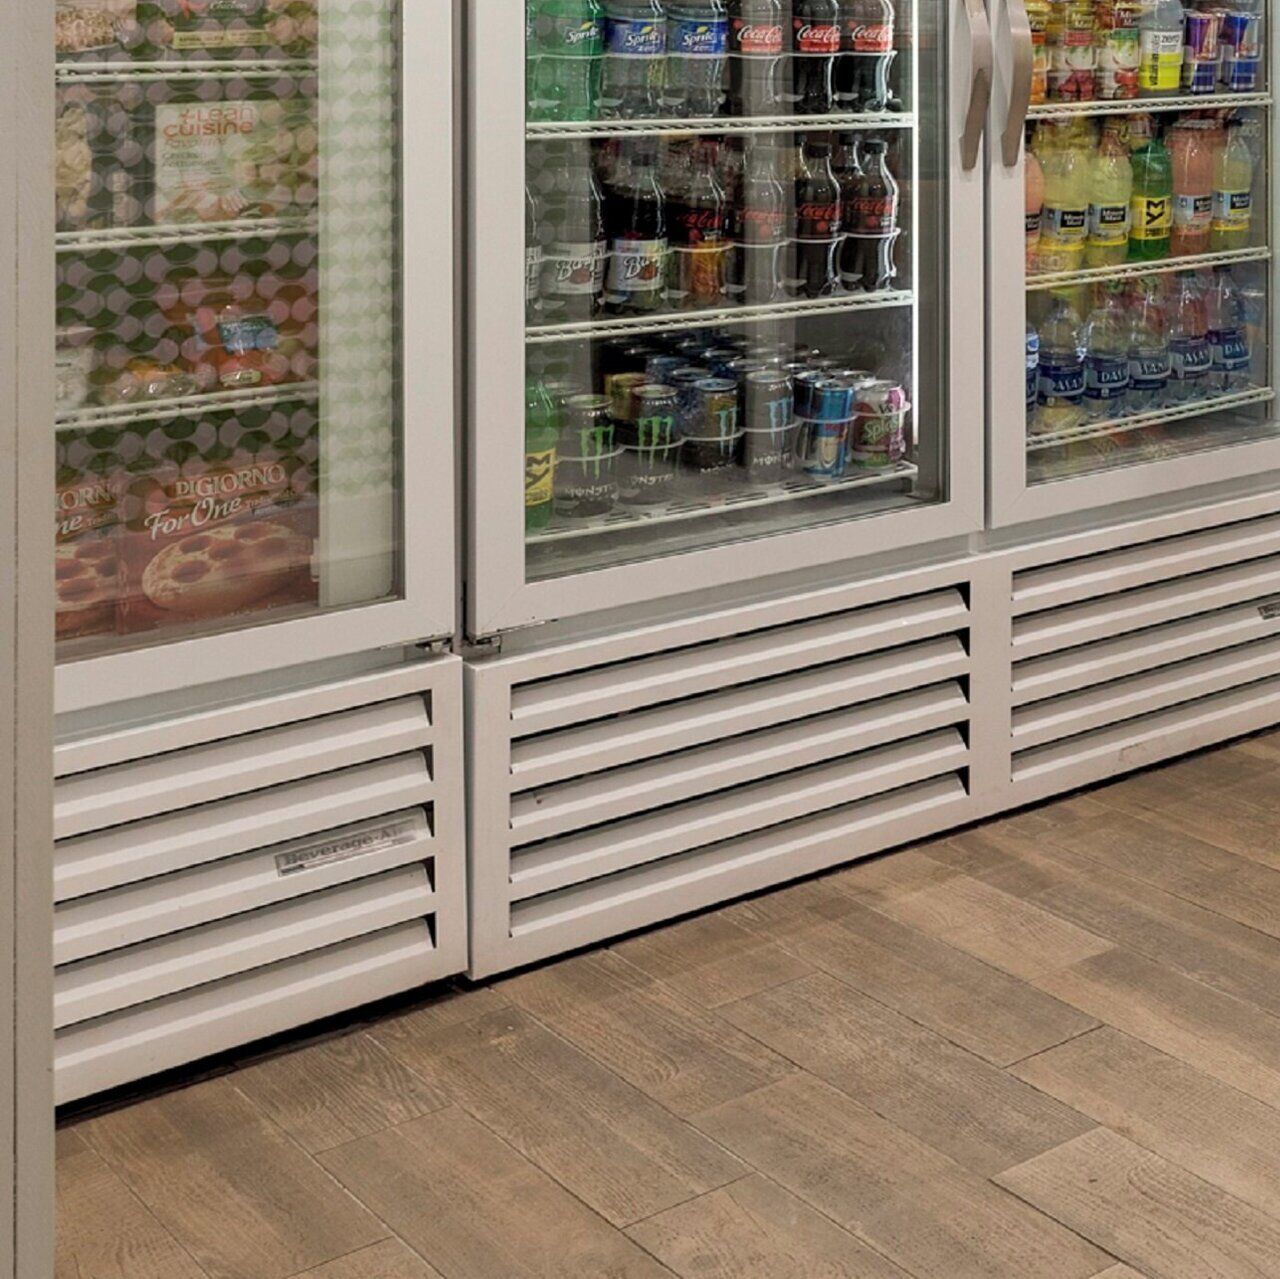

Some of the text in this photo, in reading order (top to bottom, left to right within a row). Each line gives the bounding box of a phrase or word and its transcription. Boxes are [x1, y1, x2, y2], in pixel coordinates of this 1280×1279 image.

[564, 27, 601, 44] Sprite
[682, 29, 716, 47] Sprite
[196, 106, 255, 122] Lean
[175, 463, 286, 496] DIGIORNO
[144, 496, 244, 541] For One
